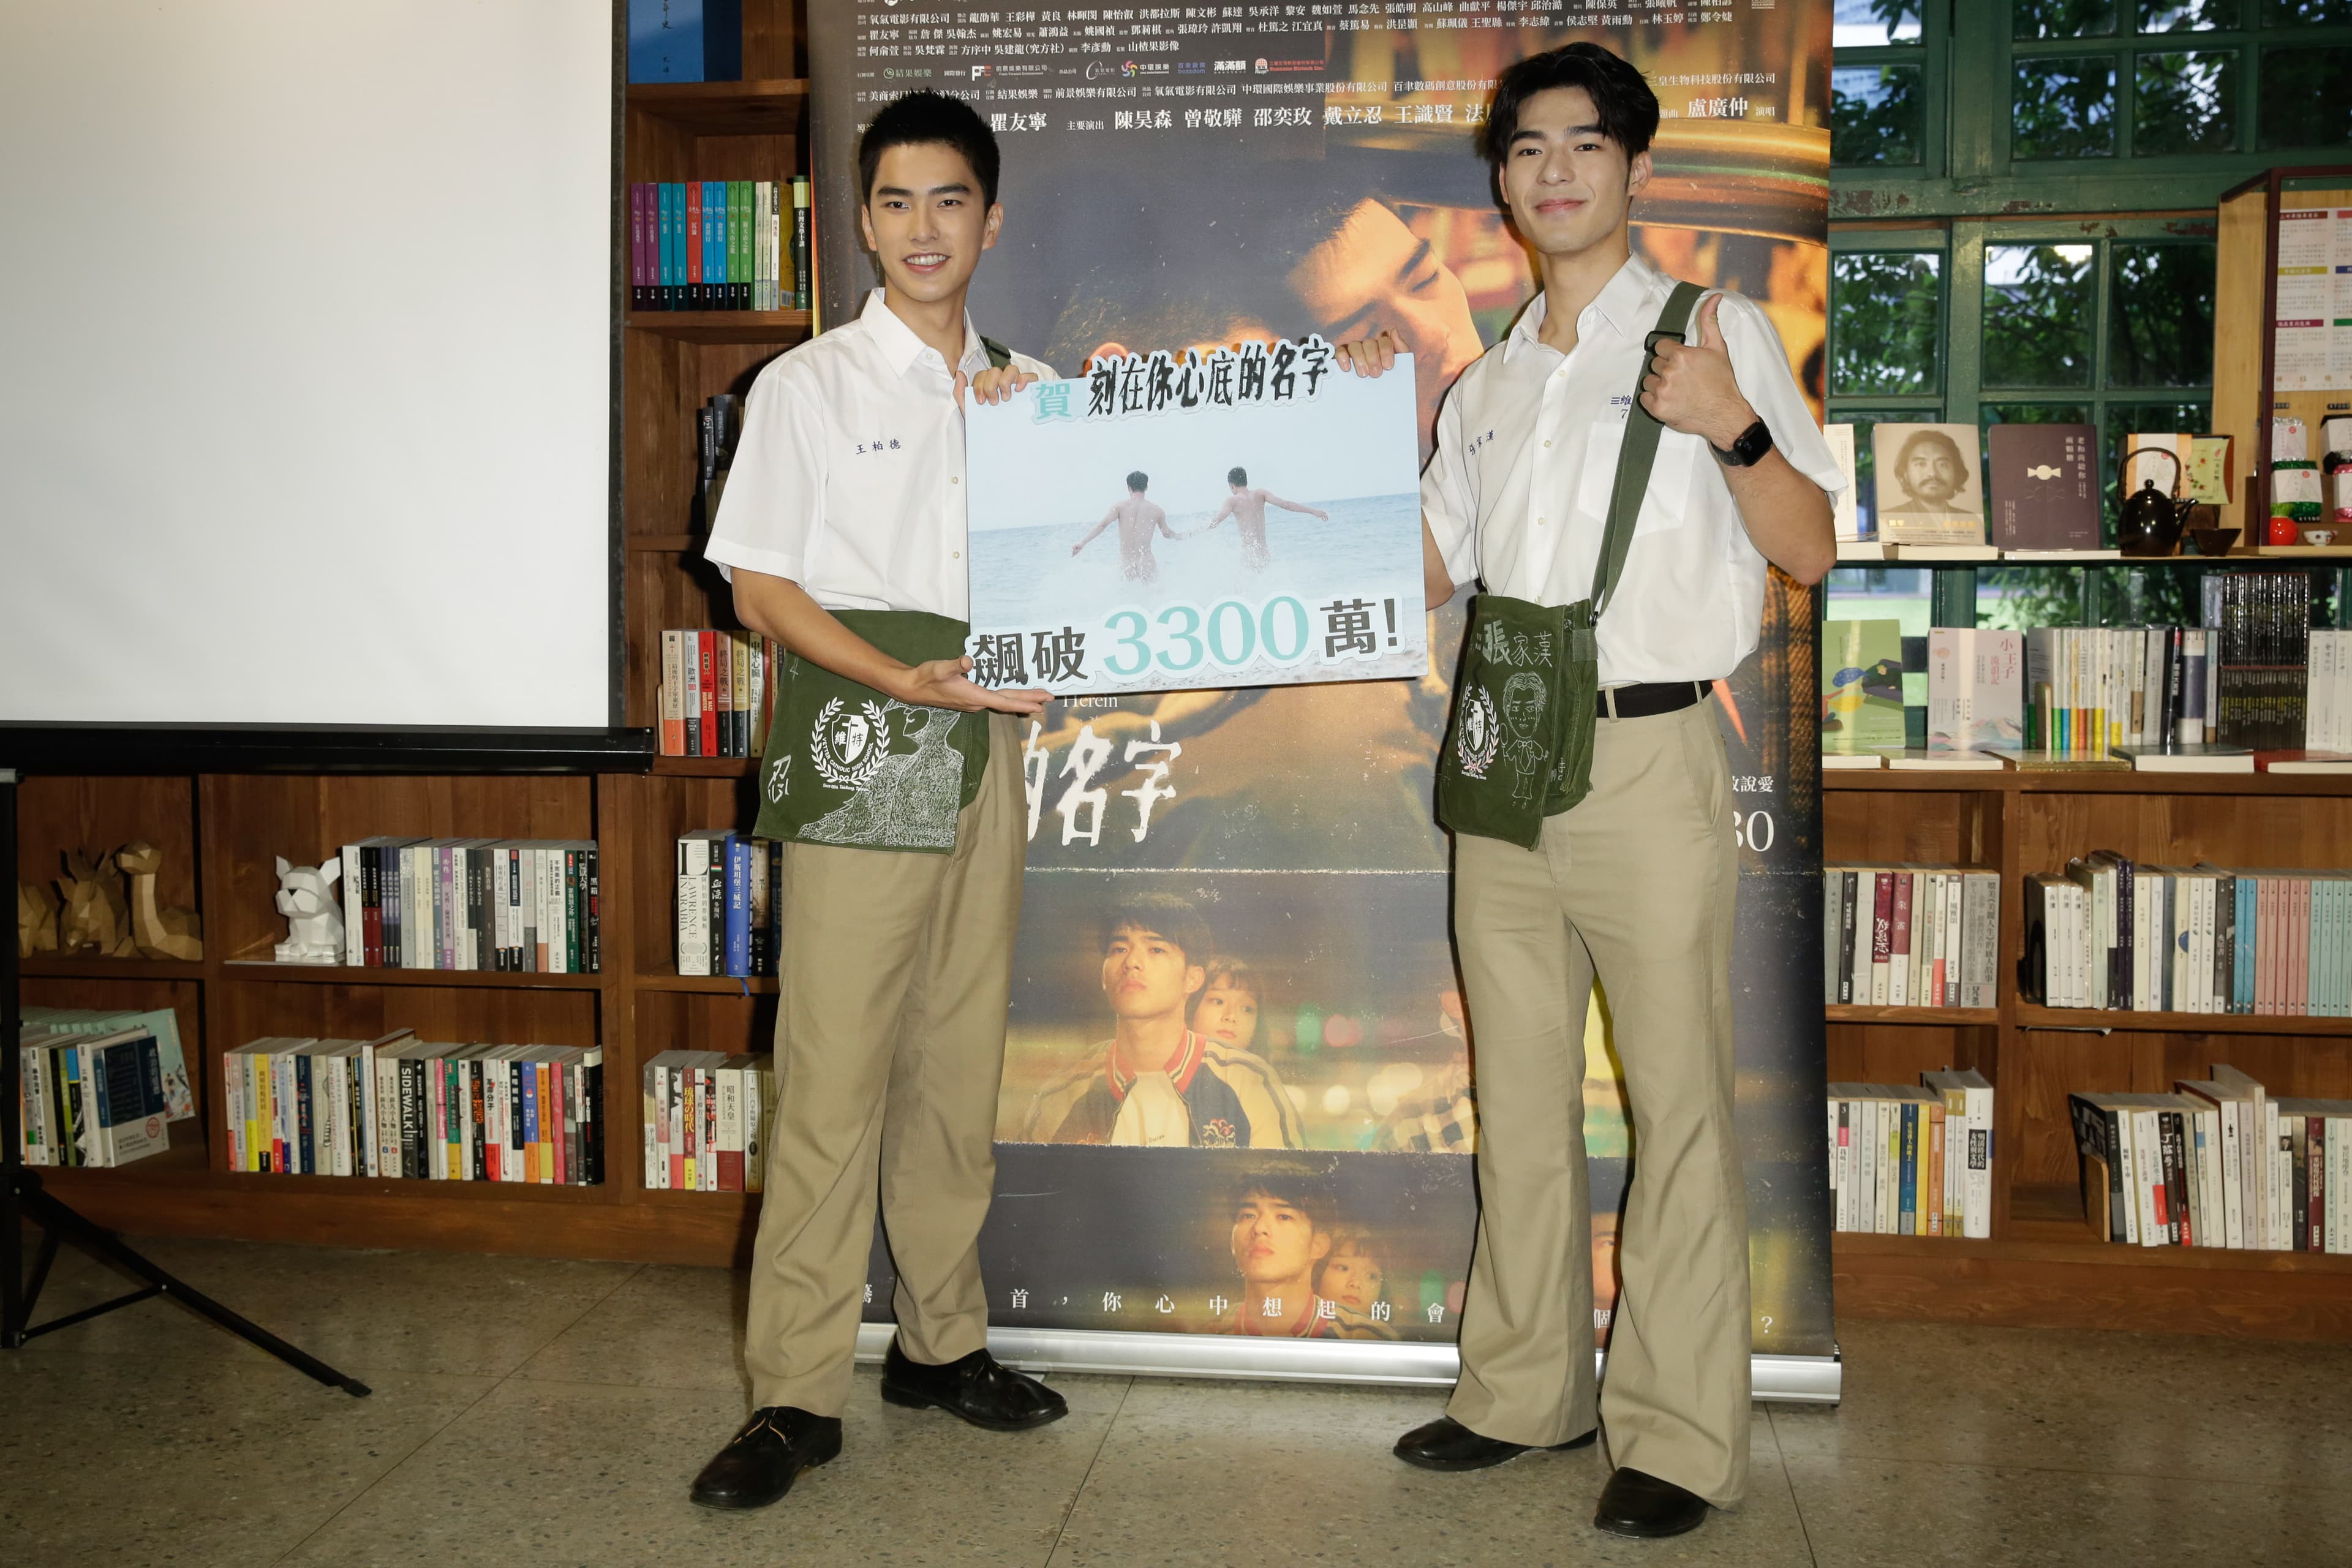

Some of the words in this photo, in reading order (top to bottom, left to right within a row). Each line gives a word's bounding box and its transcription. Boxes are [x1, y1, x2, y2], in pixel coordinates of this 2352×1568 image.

[870, 13, 949, 24] 氧氣電影有限公司
[970, 12, 1000, 23] 龍劭華
[1005, 11, 1036, 23] 王彩樺
[1041, 11, 1061, 21] 黃良
[1139, 8, 1180, 19] 洪都拉斯
[1186, 7, 1216, 18] 陳文彬
[1223, 7, 1243, 18] 蘇達
[1249, 6, 1279, 17] 吳承洋
[1286, 5, 1305, 15] 黎安
[1311, 4, 1343, 15] 魏如萱
[1348, 4, 1379, 14] 馬念先
[1422, 2, 1453, 12] 高山峰
[1460, 1, 1490, 12] 曲獻平
[870, 30, 899, 40] 瞿友寧
[992, 28, 1022, 39] 姚宏易
[1212, 23, 1242, 34] 許凱翔
[1258, 22, 1289, 32] 杜篤之
[1567, 15, 1597, 26] 侯志堅
[1652, 13, 1683, 24] 林玉婷
[961, 45, 991, 55] 方序中
[994, 43, 1064, 55] 吳建龍(究方社)
[1128, 41, 1180, 52] 山楂果影像
[997, 89, 1038, 100] 結果娛樂
[1055, 86, 1137, 99] 前景娛樂有限公司
[1155, 85, 1236, 97] 氧氣電影有限公司
[1242, 81, 1387, 96] 中環國際娛樂事業股份有限公司
[990, 112, 1047, 132] 瞿友寧
[1067, 121, 1104, 130] 主要演出
[1115, 109, 1172, 129] 陳昊森
[1185, 108, 1243, 128] 曾敬驊
[1254, 107, 1311, 126] 邵奕玫
[1324, 105, 1382, 125] 戴立忍
[1395, 104, 1452, 124] 王識賢
[1687, 97, 1748, 118] 盧廣仲
[1756, 107, 1775, 117] 演唱
[1034, 382, 1072, 421] 賀
[1087, 341, 1330, 417] 刻在你心底的名字
[1621, 409, 1628, 419] 7
[856, 439, 902, 455] 王柏德
[972, 626, 1088, 687] 飆破
[1104, 597, 1309, 676] 3300
[1321, 598, 1400, 658] 萬!
[1483, 619, 1553, 668] 張家漢
[2000, 638, 2016, 679] 小王子
[720, 650, 729, 686] 終局之戰
[736, 650, 745, 686] 終局之戰
[1063, 696, 1118, 707] Herein
[823, 737, 831, 761] VETTER
[829, 759, 851, 773] CATHOLIC
[851, 762, 864, 772] HIGH
[862, 742, 874, 764] SCHOOL
[834, 731, 864, 747] 維特
[688, 877, 697, 940] LAWRENCE
[402, 1068, 413, 1129] SIDEWALK
[684, 1086, 694, 1133] 琉球の時代
[726, 1085, 735, 1121] 昭和天皇
